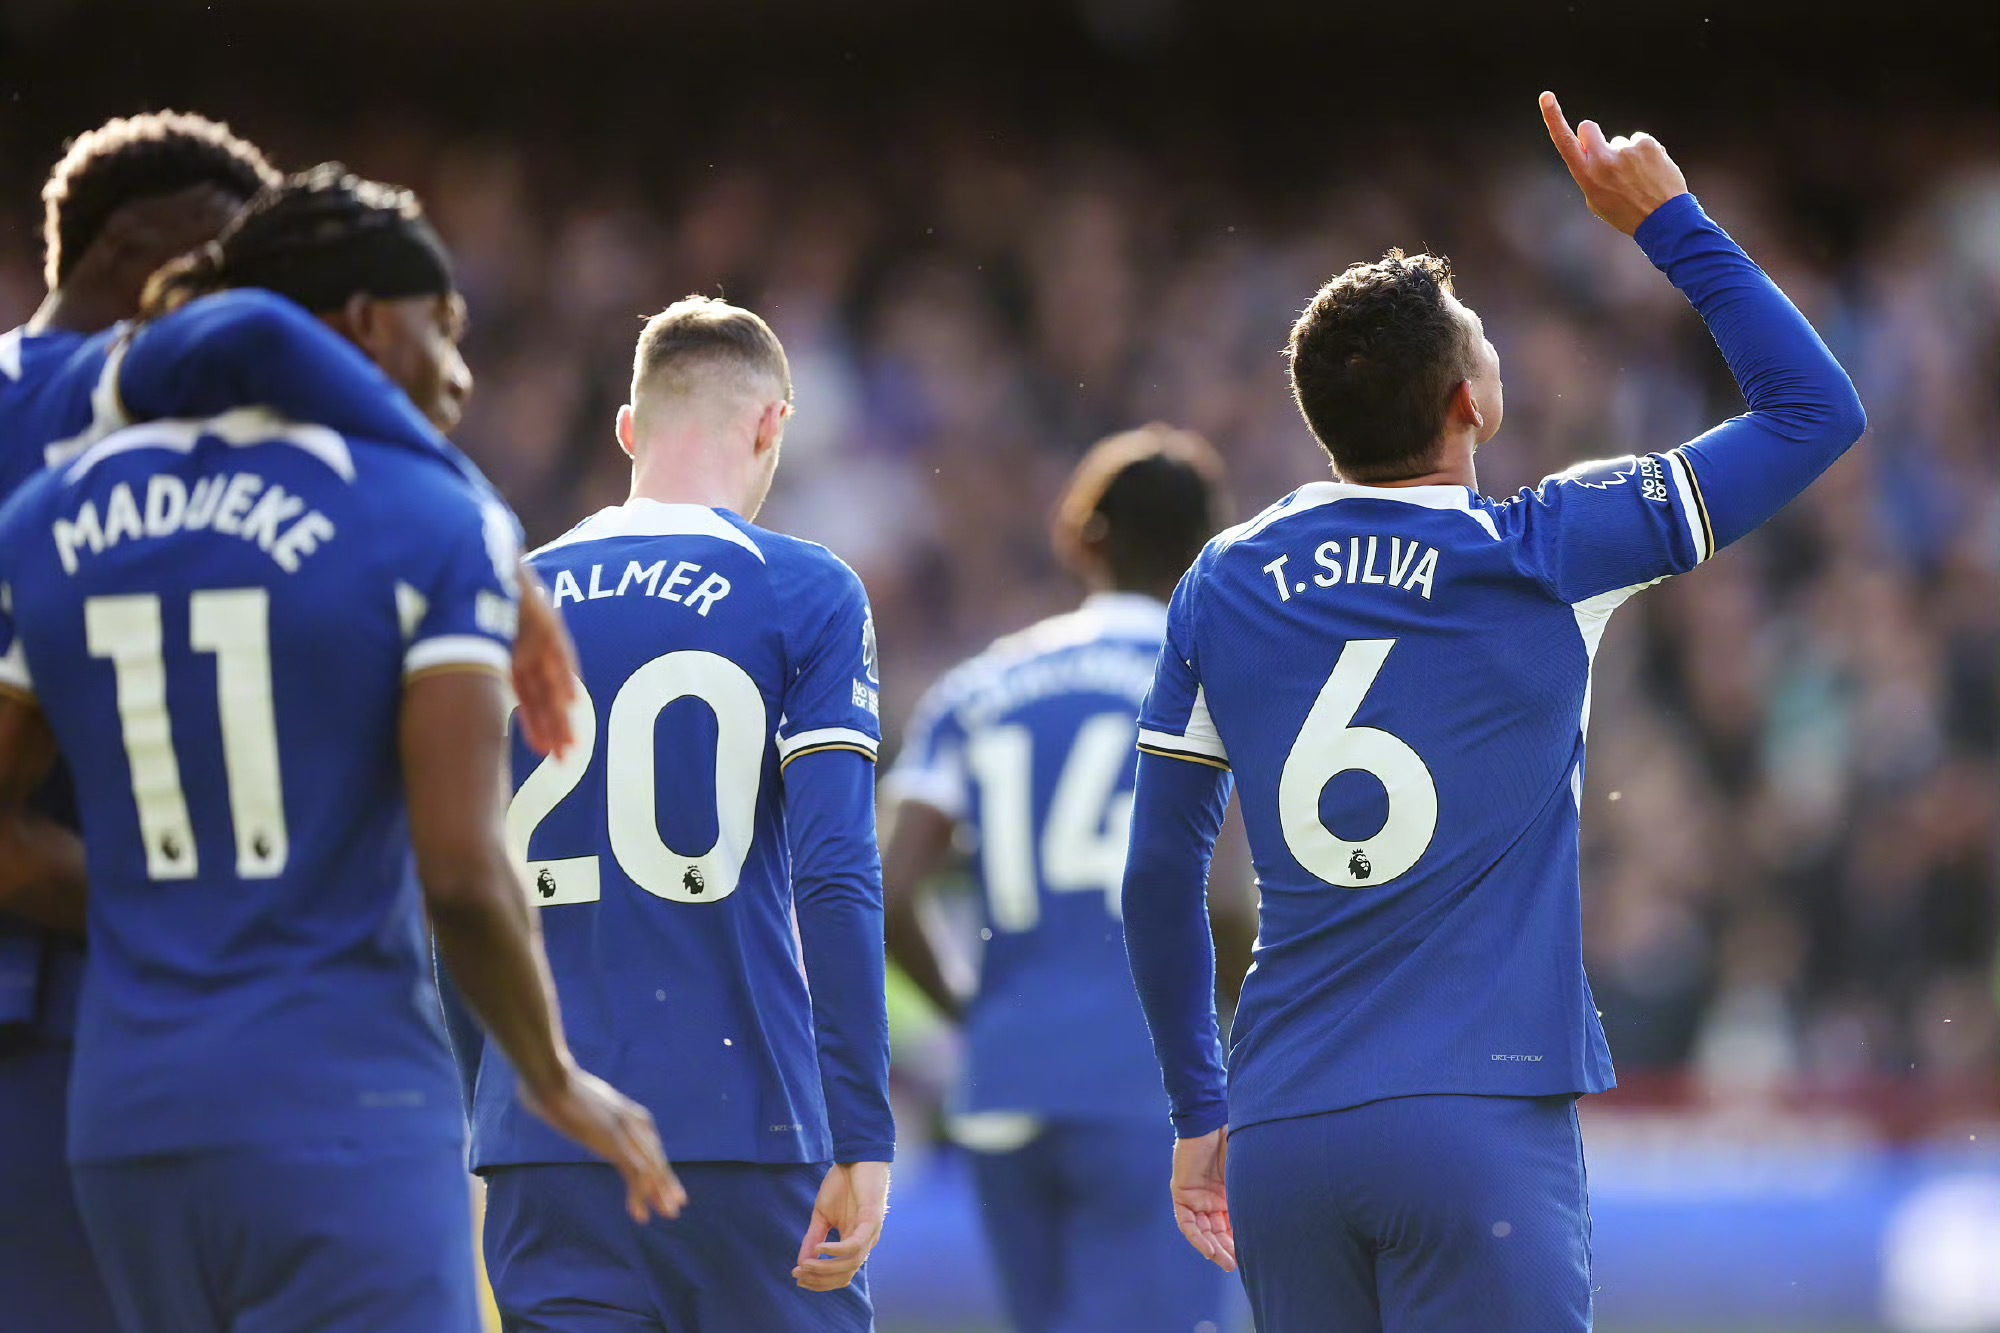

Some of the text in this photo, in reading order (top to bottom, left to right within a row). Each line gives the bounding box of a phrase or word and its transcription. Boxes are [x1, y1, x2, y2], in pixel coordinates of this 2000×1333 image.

[53, 473, 336, 575] MADUEKE
[1263, 536, 1440, 602] T. SILVA
[1641, 479, 1655, 500] No
[536, 560, 731, 617] ALMER
[84, 588, 288, 881] 11
[505, 650, 767, 908] 20
[1278, 638, 1438, 888] 6
[966, 711, 1136, 933] 14
